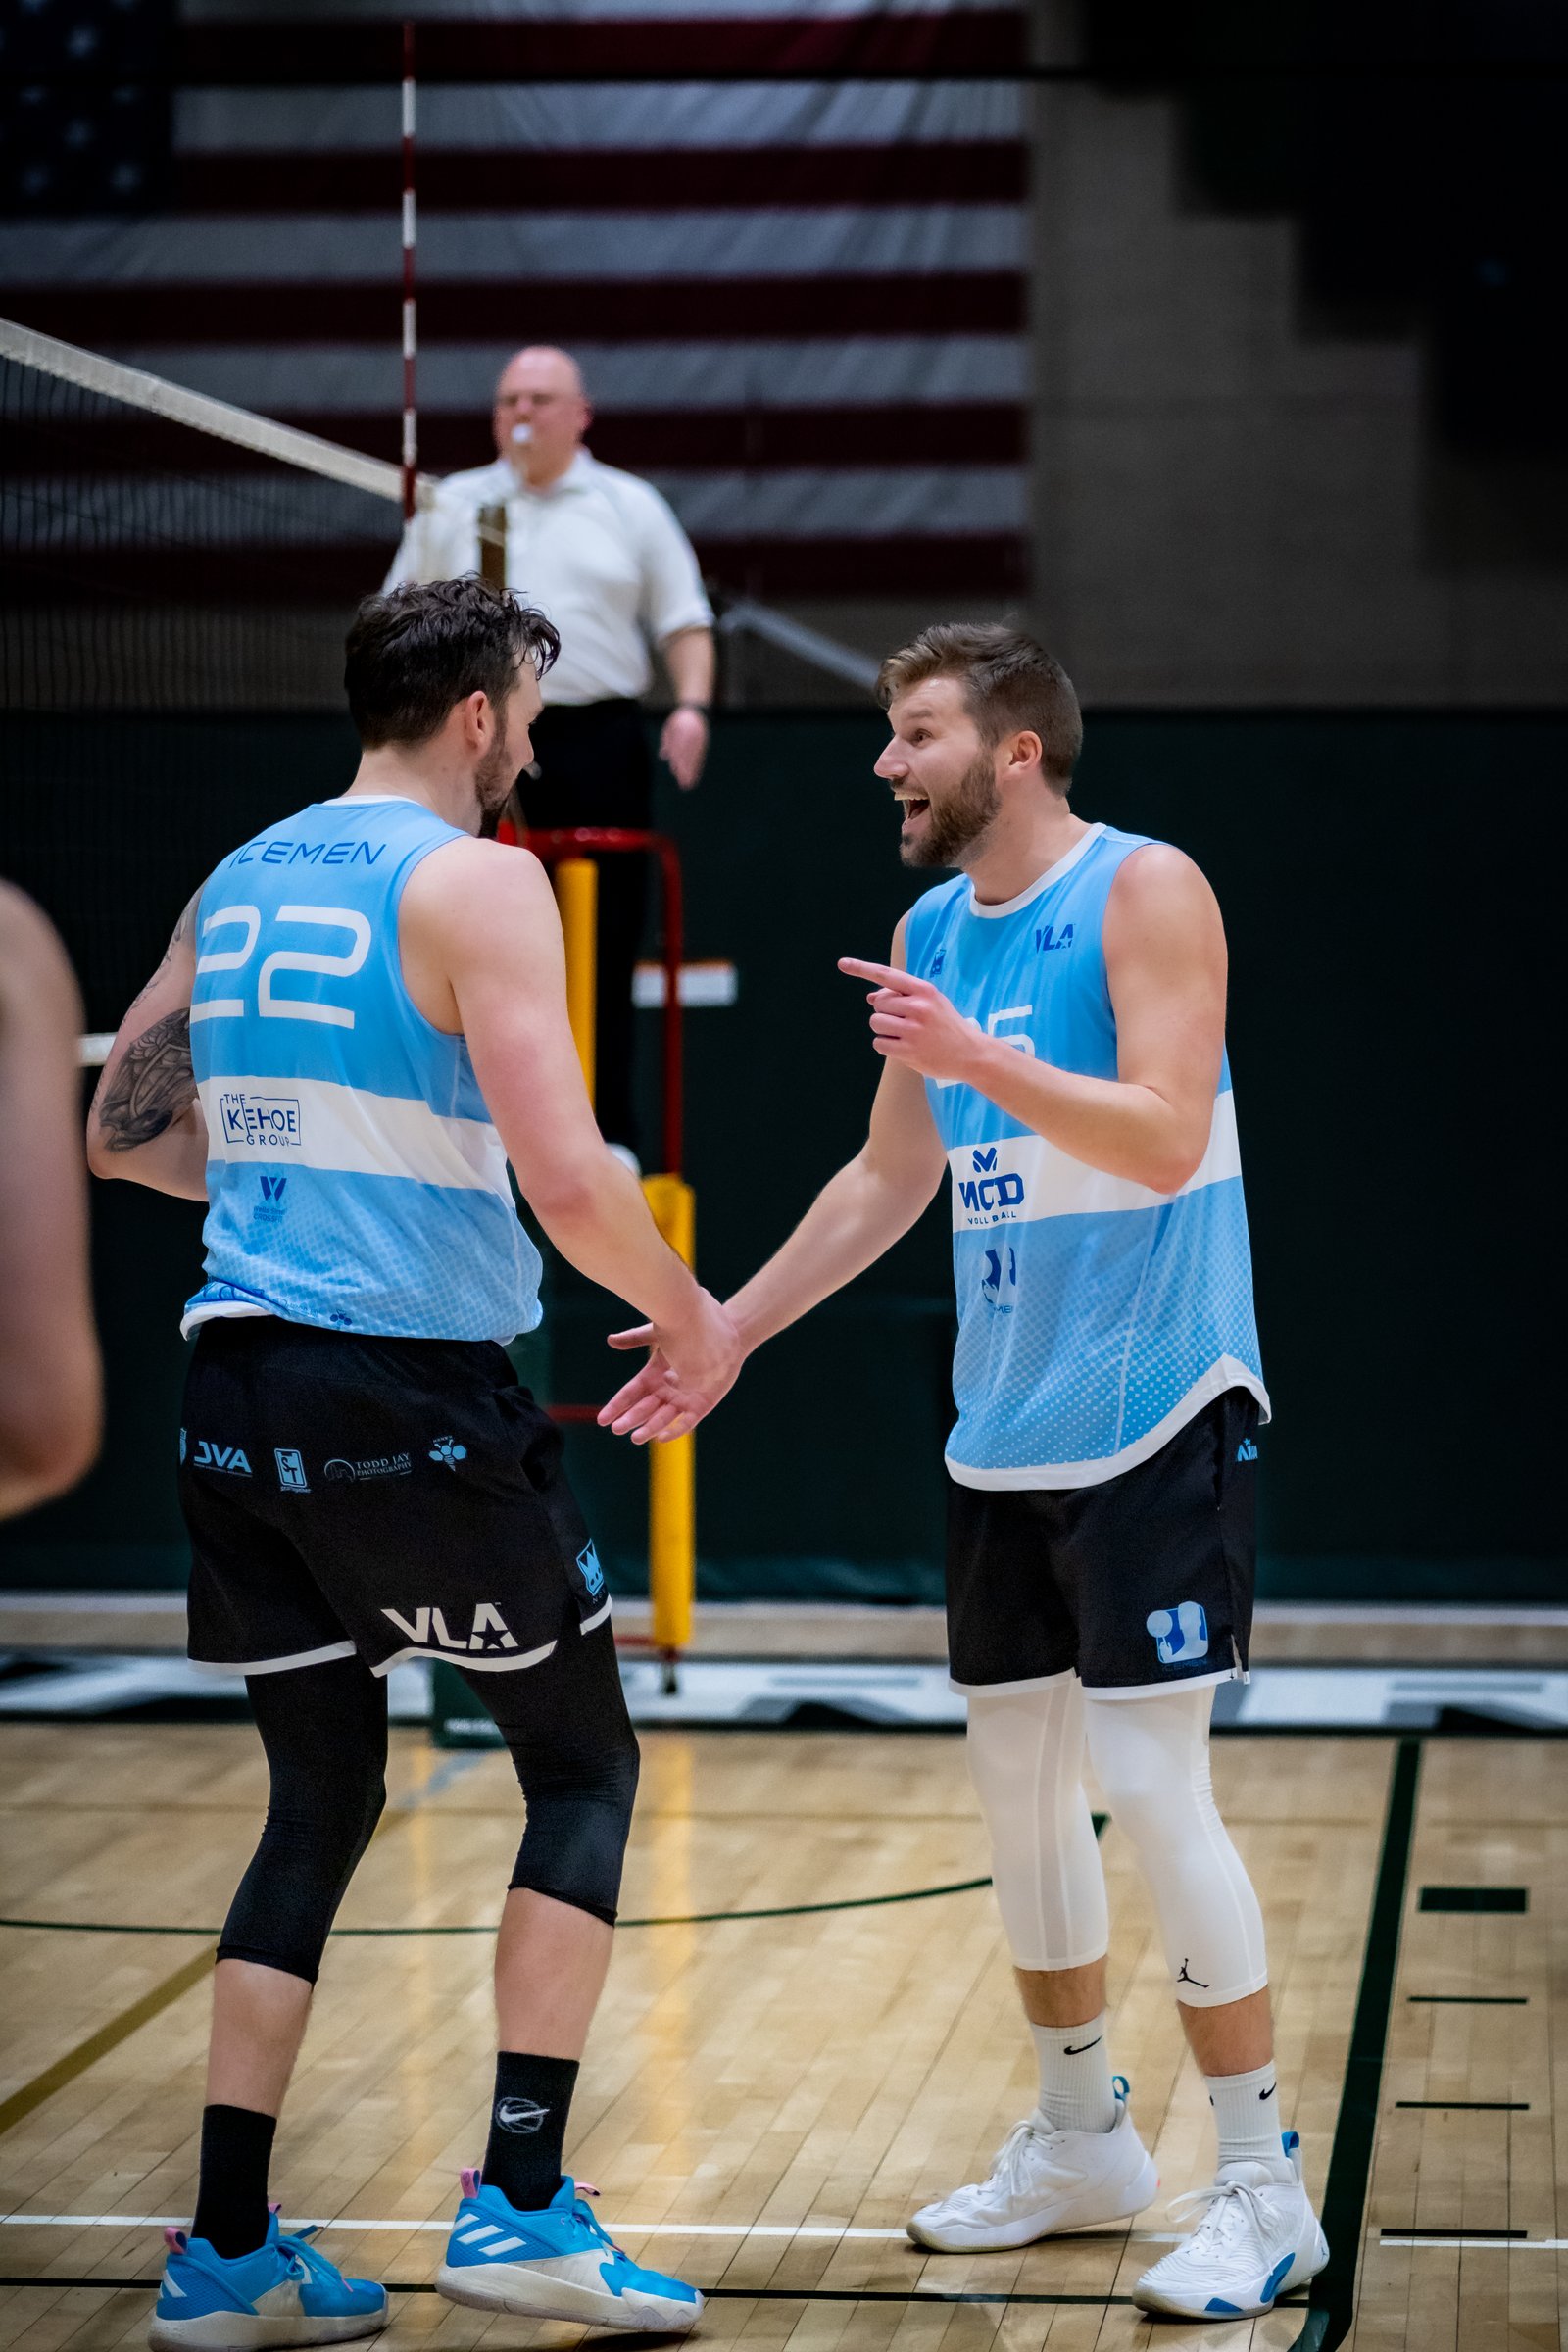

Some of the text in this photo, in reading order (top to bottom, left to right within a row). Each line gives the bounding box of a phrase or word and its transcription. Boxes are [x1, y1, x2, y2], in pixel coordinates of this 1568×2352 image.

[229, 841, 387, 868] ICEMEN
[1035, 924, 1074, 954] VLA
[190, 905, 372, 1029] 22
[223, 1094, 246, 1104] THE
[227, 1108, 296, 1132] KEHOE
[247, 1134, 290, 1147] GROUP
[194, 1440, 252, 1473] JVA
[355, 1452, 410, 1469] TODD JAY
[356, 1461, 412, 1476] PHOTOGRAPHY
[380, 1603, 518, 1649] VLA
